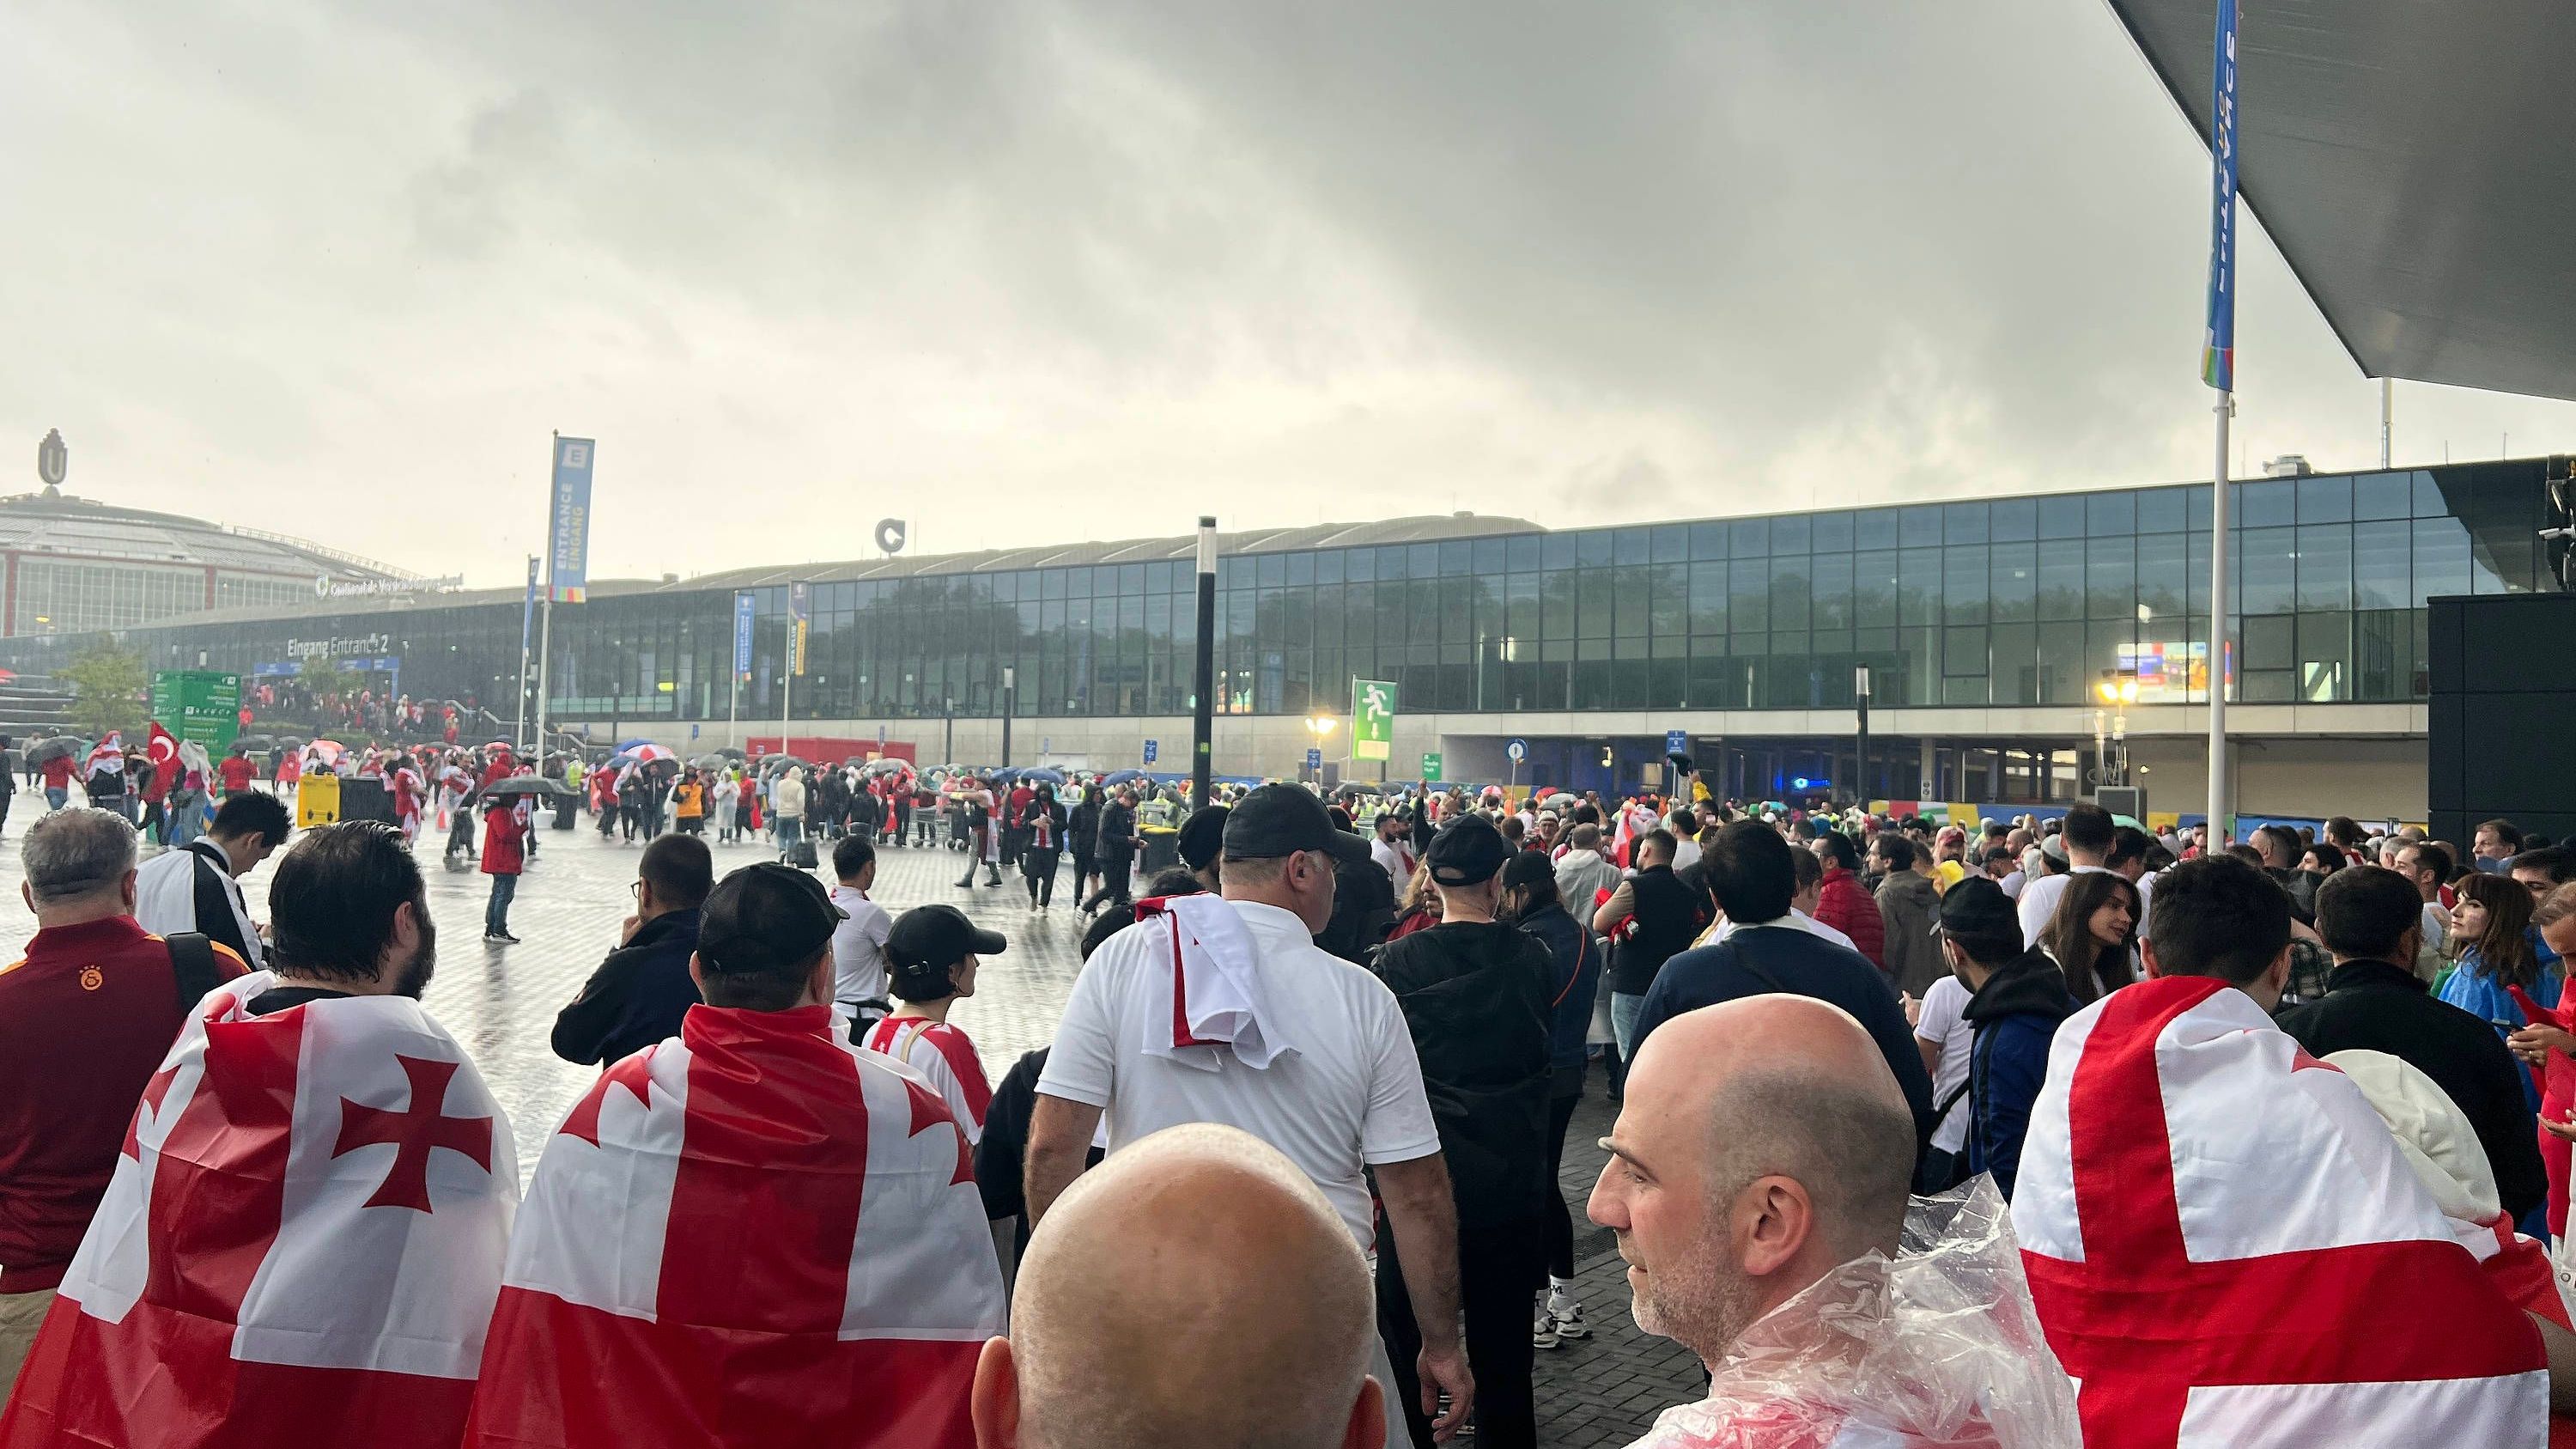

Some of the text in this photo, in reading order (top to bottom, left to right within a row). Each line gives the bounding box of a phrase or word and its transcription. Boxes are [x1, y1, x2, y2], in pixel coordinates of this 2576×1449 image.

[557, 482, 573, 569] ENTRANCE
[568, 506, 584, 571] EINGANG
[288, 637, 329, 661] Eingang
[380, 634, 389, 654] 2
